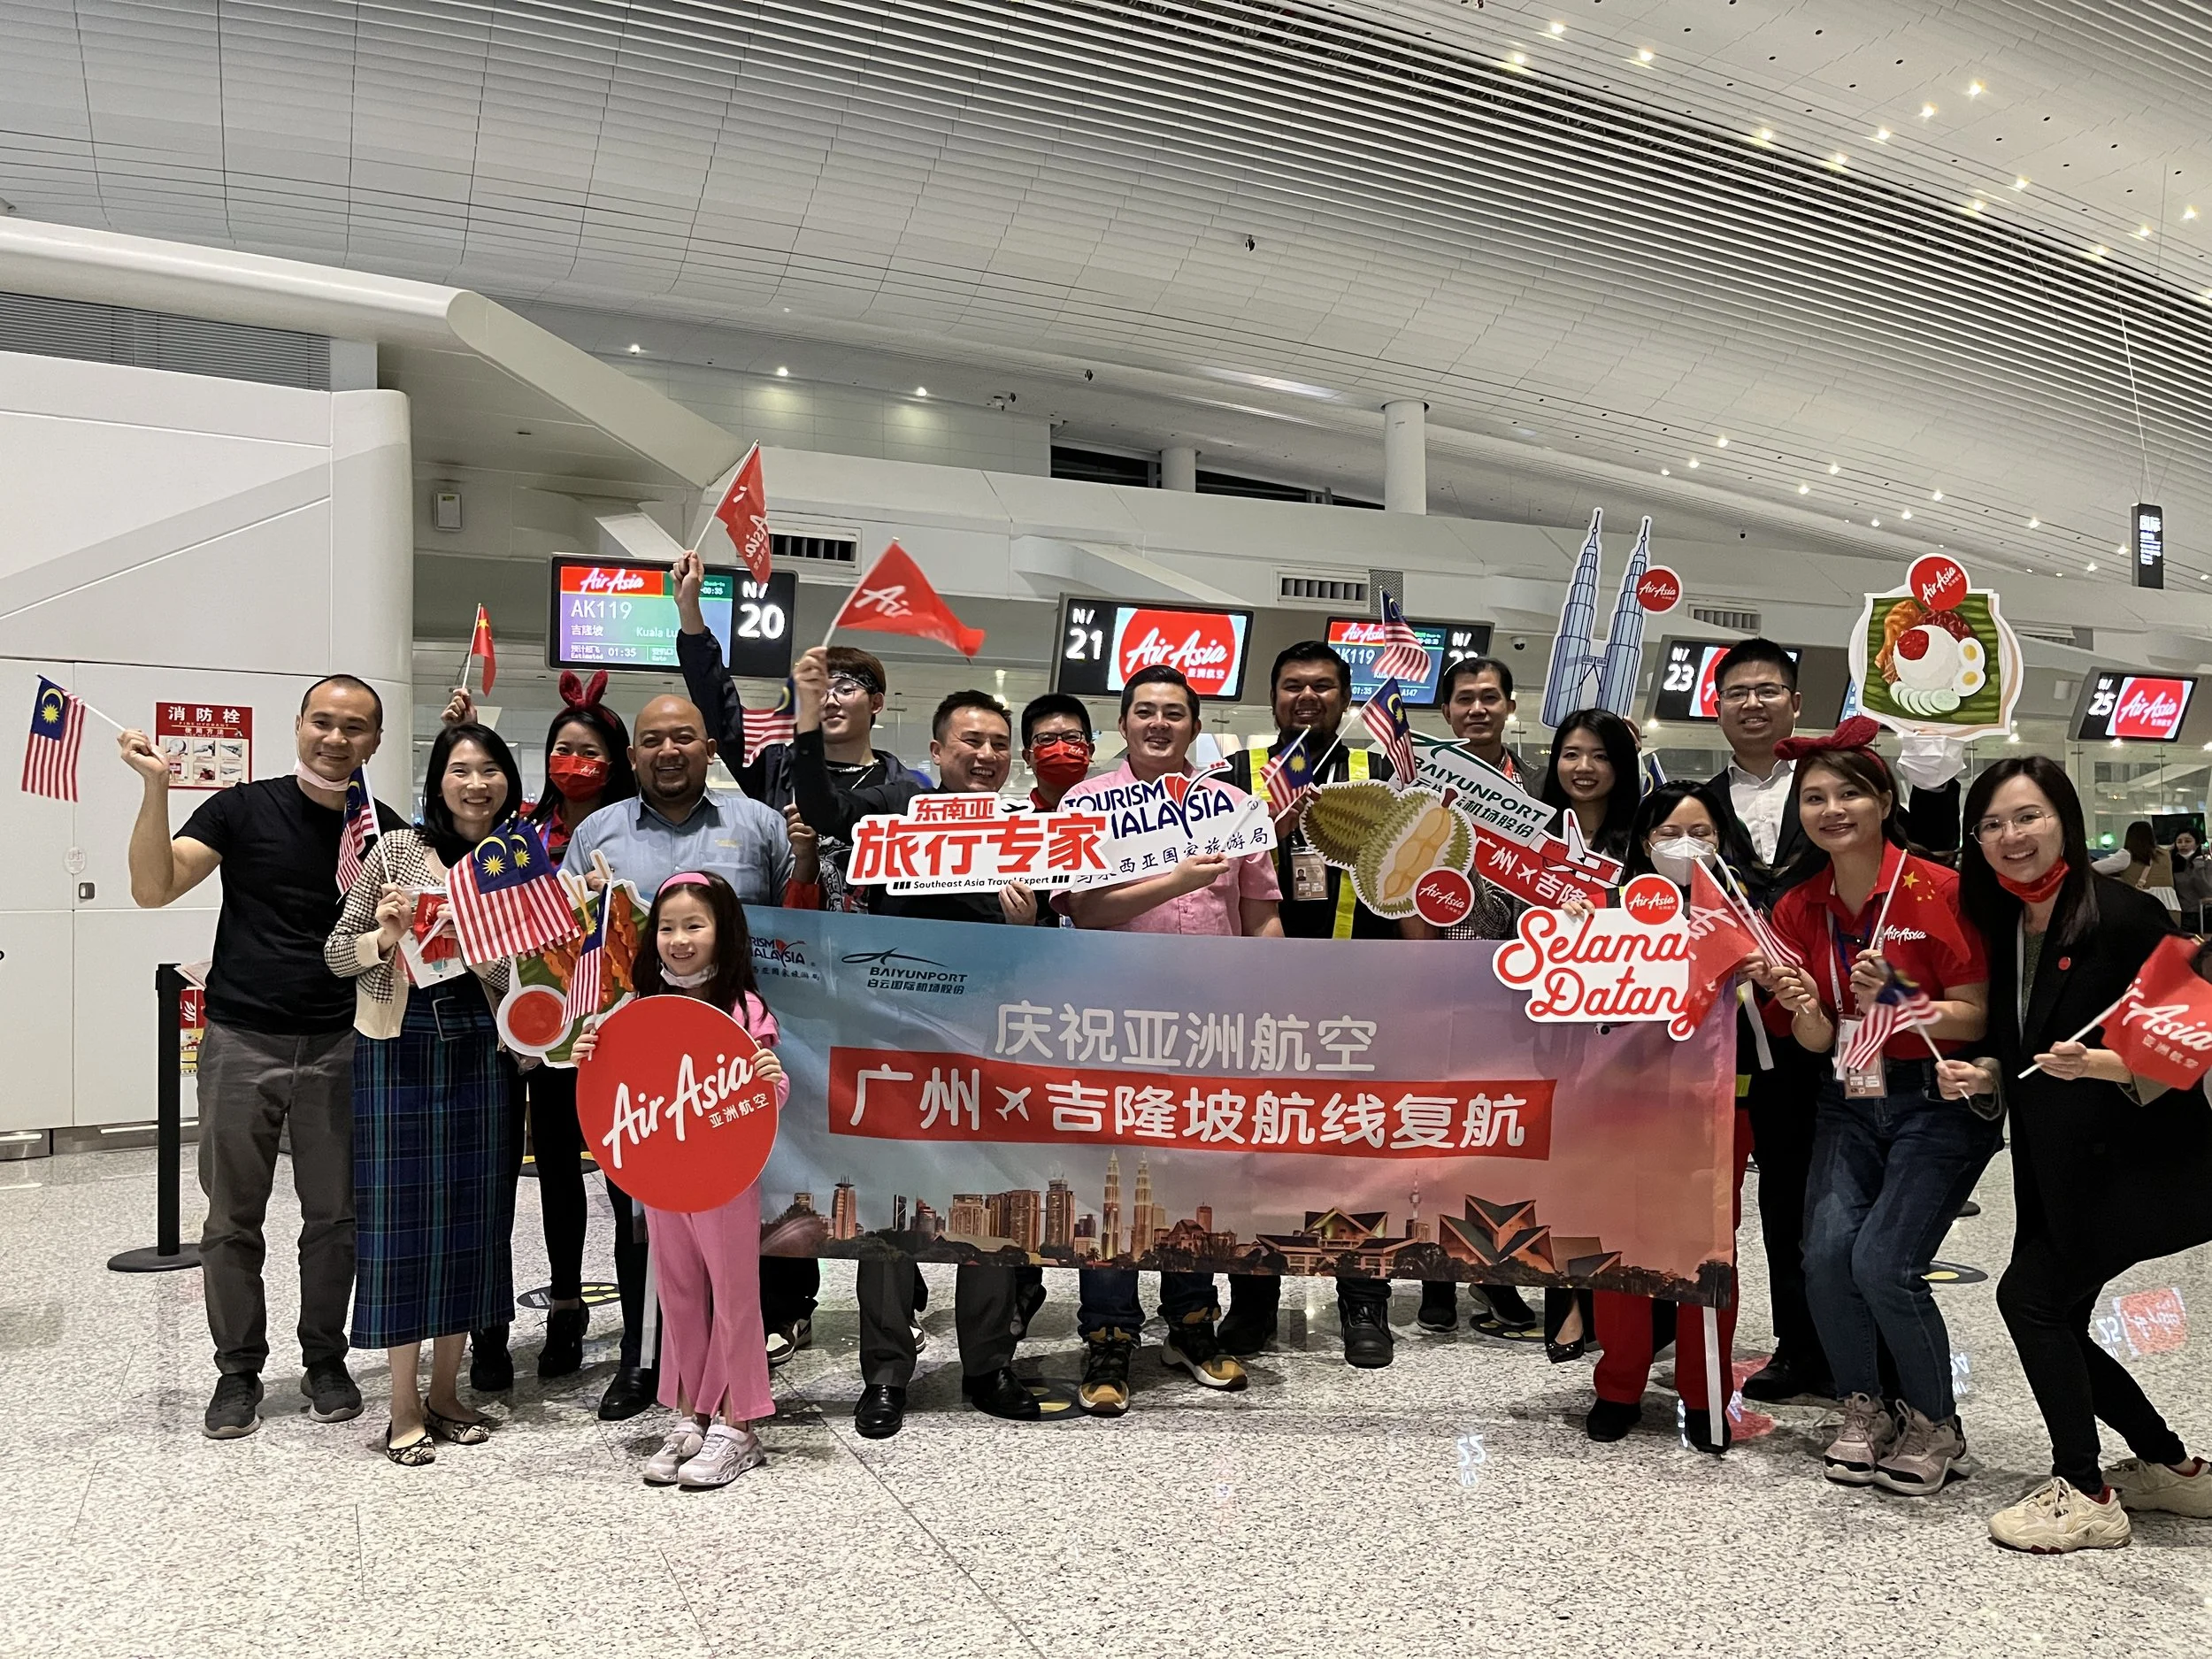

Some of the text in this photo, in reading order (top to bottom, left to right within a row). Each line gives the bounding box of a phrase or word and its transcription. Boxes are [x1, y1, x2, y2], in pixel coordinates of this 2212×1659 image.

[1639, 580, 1676, 598] AirAsia
[1922, 566, 1956, 606] AirAsia
[571, 599, 633, 619] AK119
[737, 603, 786, 640] 20
[571, 624, 604, 637] 吉隆坡
[636, 626, 664, 638] Kuala
[608, 647, 637, 657] 01:35
[1065, 627, 1104, 661] 21
[1125, 626, 1229, 675] AirAsia
[1443, 649, 1479, 676] 2
[1663, 664, 1696, 692] 23
[168, 706, 241, 724] 消防栓
[2087, 692, 2117, 717] 25
[915, 797, 995, 822] 东南亚
[852, 813, 1107, 879] 旅行专家
[914, 879, 962, 889] Southeast
[964, 878, 986, 887] Asia
[1418, 883, 1465, 909] AirAsia
[1628, 891, 1676, 911] AirAsia
[1497, 909, 1687, 984] Selama
[1884, 924, 1927, 945] AirAsia
[867, 979, 965, 995] 白云国际机场股份
[869, 966, 968, 984] BAIYUNPORT
[995, 1000, 1378, 1071] 庆祝亚洲航空
[602, 1053, 754, 1169] AirAsia
[708, 1093, 770, 1129] 亚洲航空
[849, 1064, 1527, 1149] 广州 吉隆坡航线复航
